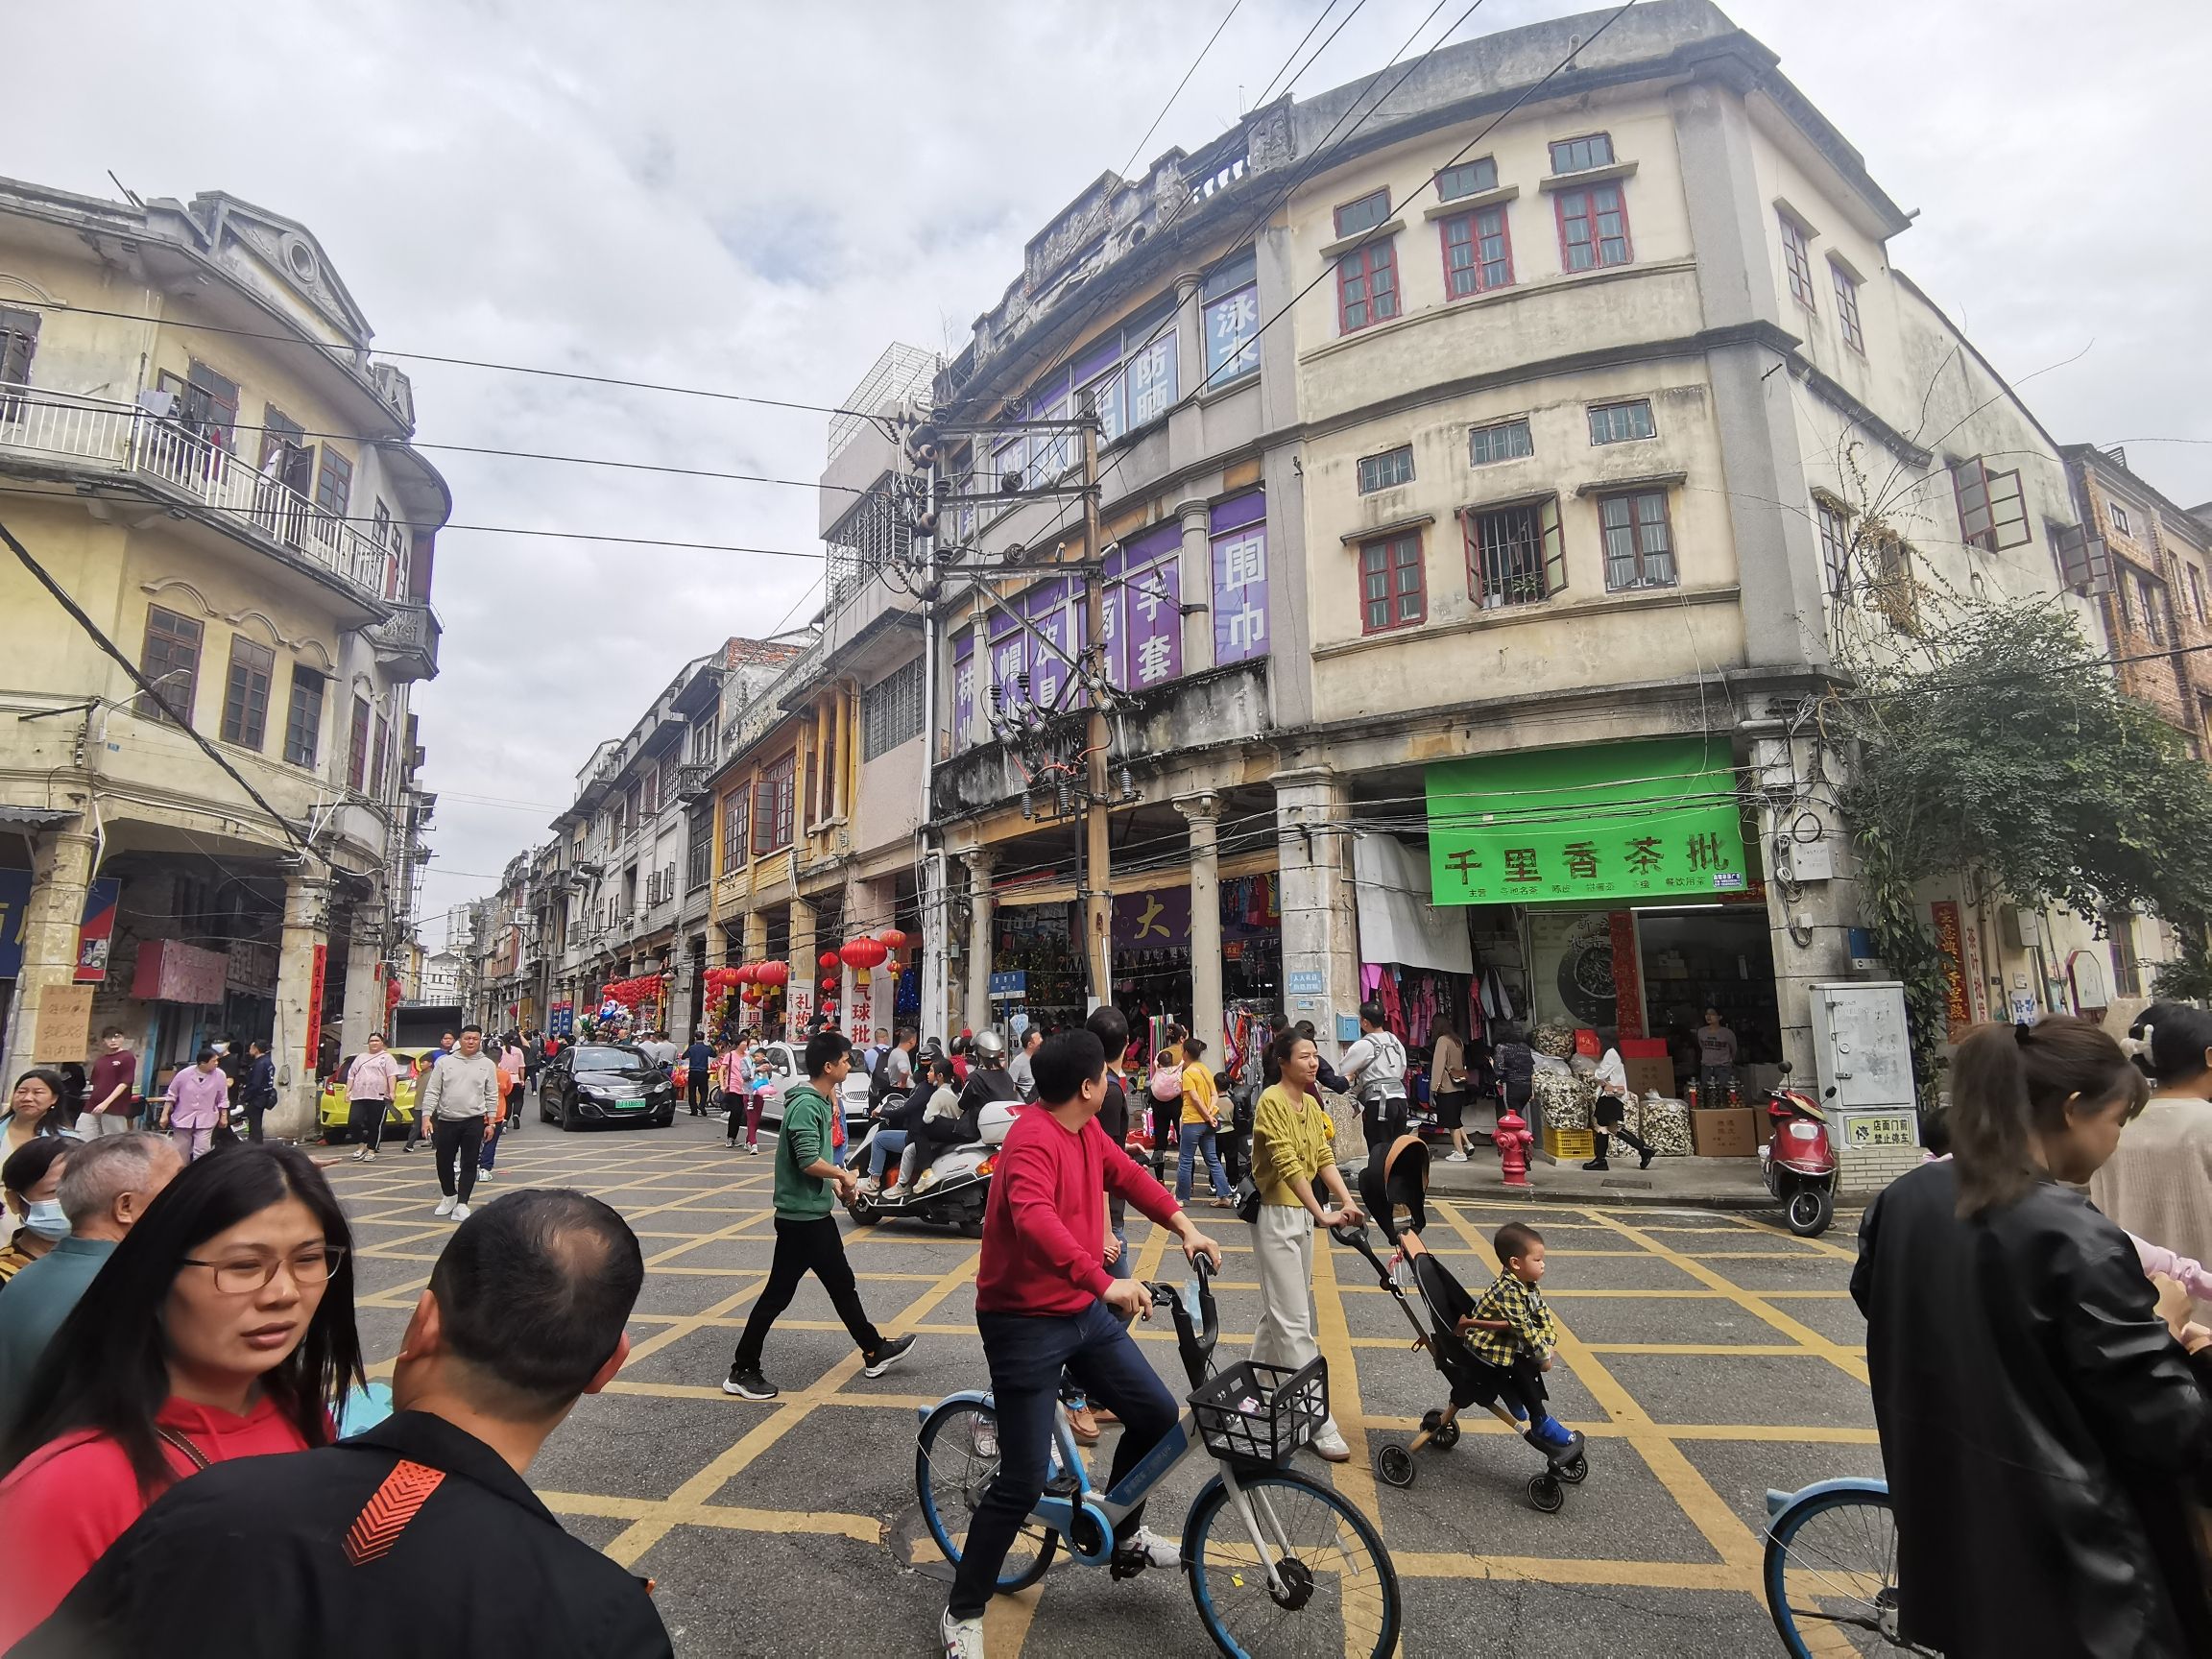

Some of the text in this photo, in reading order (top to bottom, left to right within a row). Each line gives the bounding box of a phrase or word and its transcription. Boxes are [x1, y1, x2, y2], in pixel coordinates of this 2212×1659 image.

[1215, 294, 1259, 374] 泳衣
[1136, 345, 1168, 423] 防晒
[1136, 568, 1173, 684] 手套
[1224, 534, 1267, 652] 围巾
[1444, 831, 1729, 886] 千里香茶批
[852, 983, 872, 1045] 气球批
[1873, 1118, 1909, 1132] 店面门前
[1874, 1132, 1910, 1145] 禁止停车
